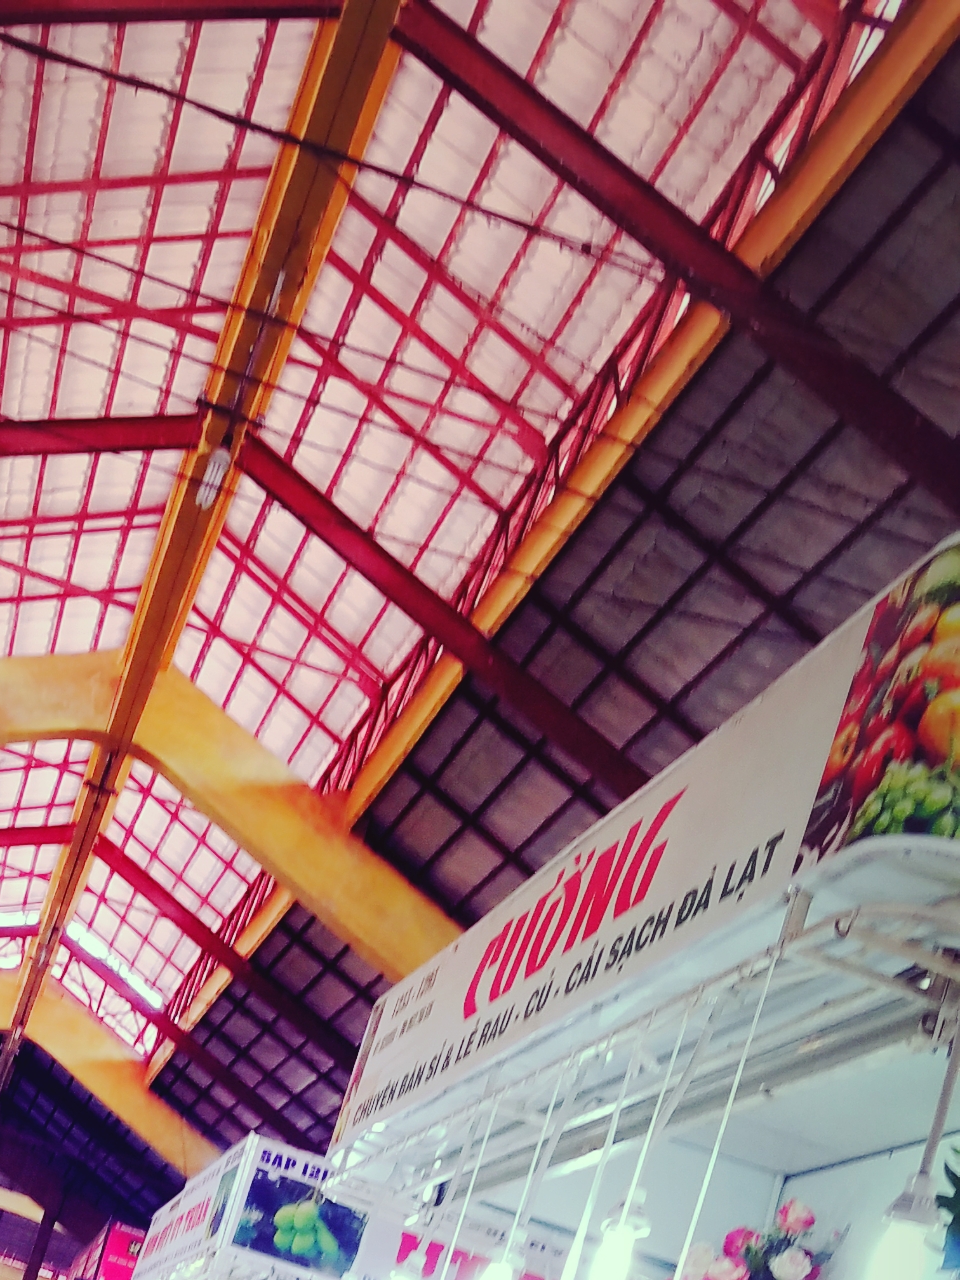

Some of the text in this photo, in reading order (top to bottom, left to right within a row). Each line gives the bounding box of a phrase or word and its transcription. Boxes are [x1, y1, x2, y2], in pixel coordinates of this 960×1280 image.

[352, 1075, 397, 1127] CHUYÊN
[396, 1059, 427, 1101] BÁN
[440, 1048, 456, 1075] &
[476, 1002, 517, 1052] RAU
[603, 900, 676, 975] SẠCH
[718, 827, 787, 904] LẠT
[463, 783, 690, 1022] CƯỜNG
